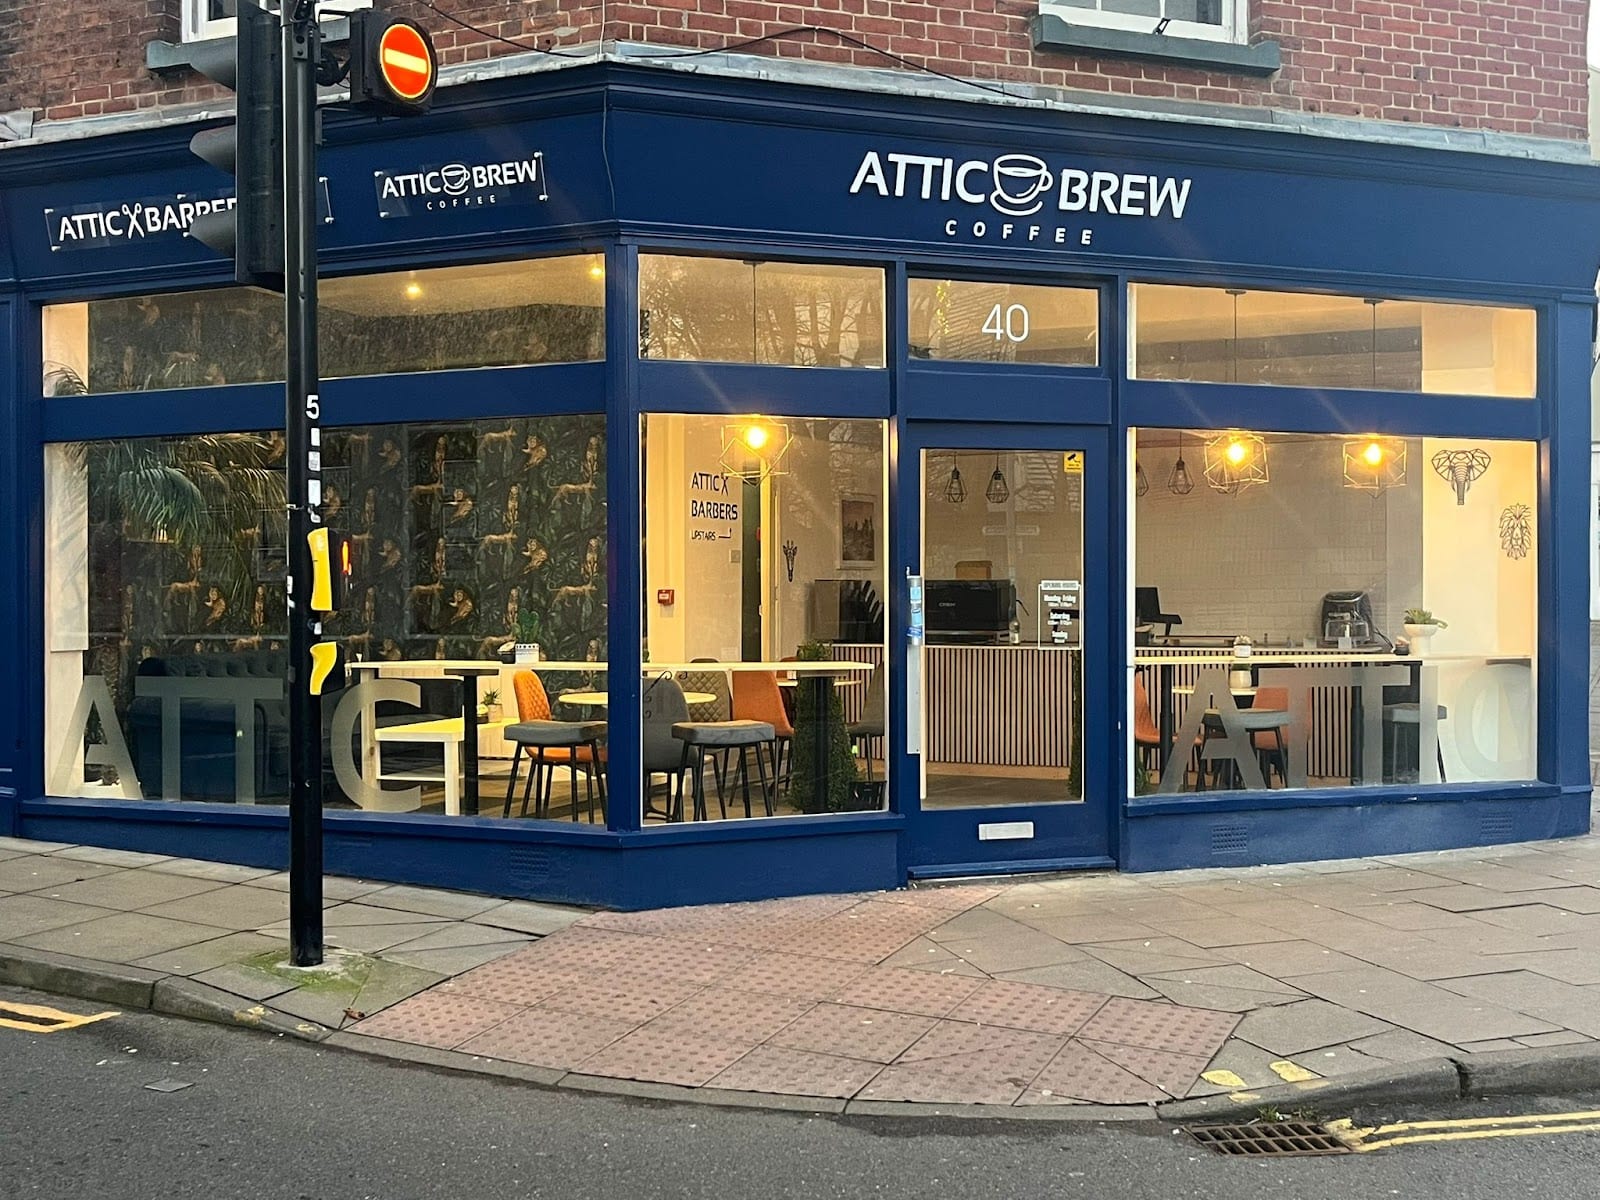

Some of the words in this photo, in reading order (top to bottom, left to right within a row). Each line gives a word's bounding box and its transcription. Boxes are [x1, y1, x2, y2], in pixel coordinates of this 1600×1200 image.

[381, 171, 442, 199] ATTIC
[471, 159, 537, 189] BREW
[849, 150, 989, 204] ATTIC
[1058, 168, 1192, 219] BREW
[426, 194, 496, 211] COFFEE
[59, 210, 124, 241] ATTIC
[944, 219, 1093, 245] COFFEE
[981, 303, 1029, 343] 40
[305, 394, 320, 420] 5
[691, 472, 720, 491] ATTIC
[691, 500, 738, 520] BARBERS
[48, 674, 422, 813] ATTC
